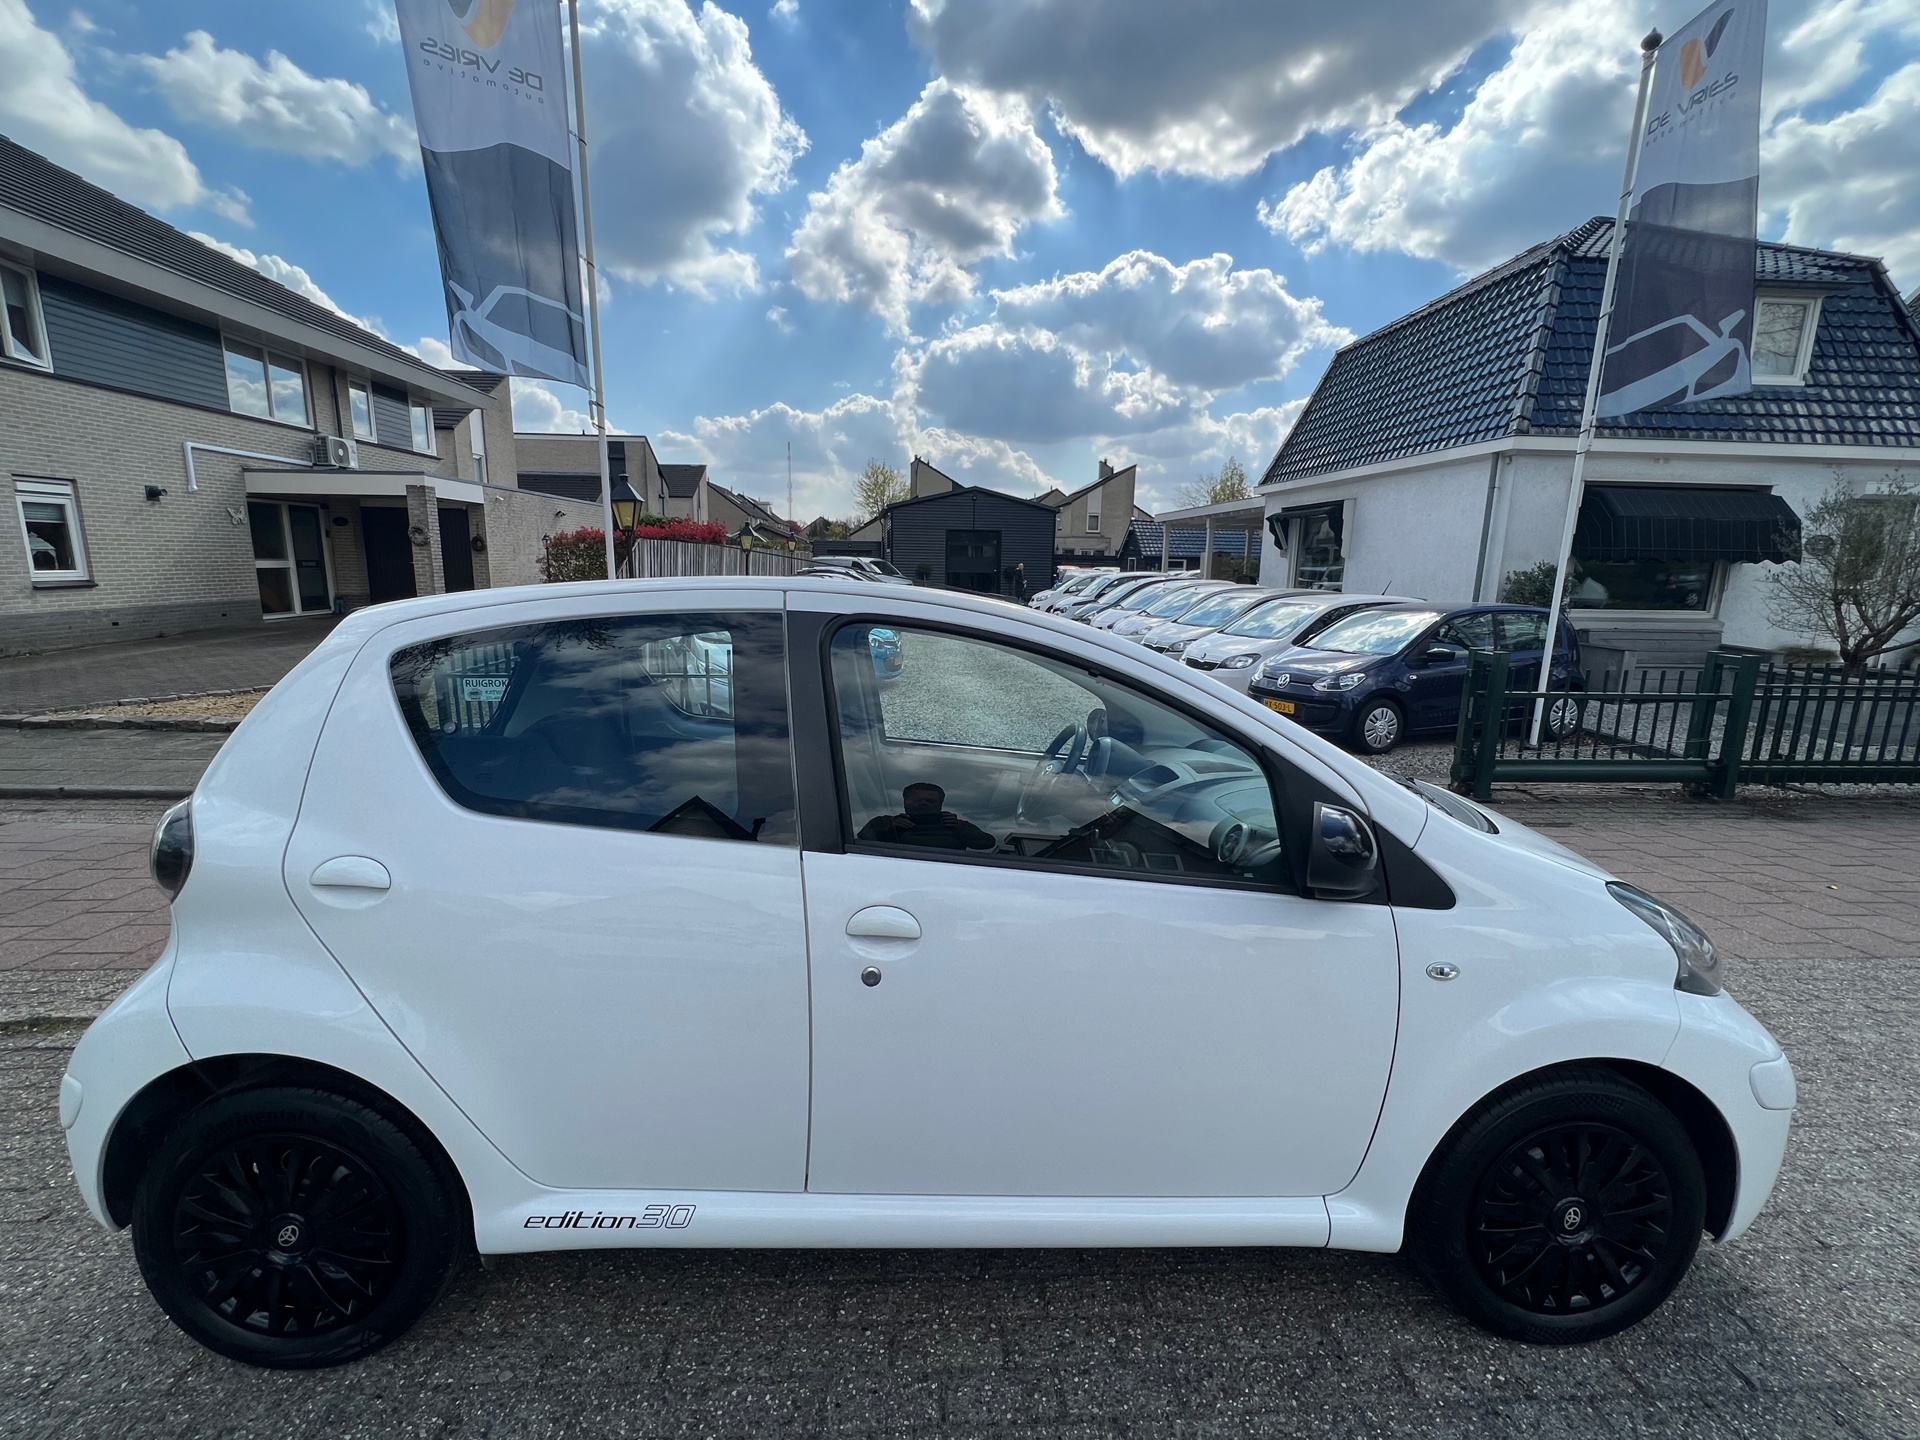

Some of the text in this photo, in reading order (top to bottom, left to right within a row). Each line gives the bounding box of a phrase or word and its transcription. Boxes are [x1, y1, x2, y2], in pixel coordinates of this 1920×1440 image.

[1648, 71, 1739, 136] DE VRIES
[465, 679, 508, 688] RUIGROK
